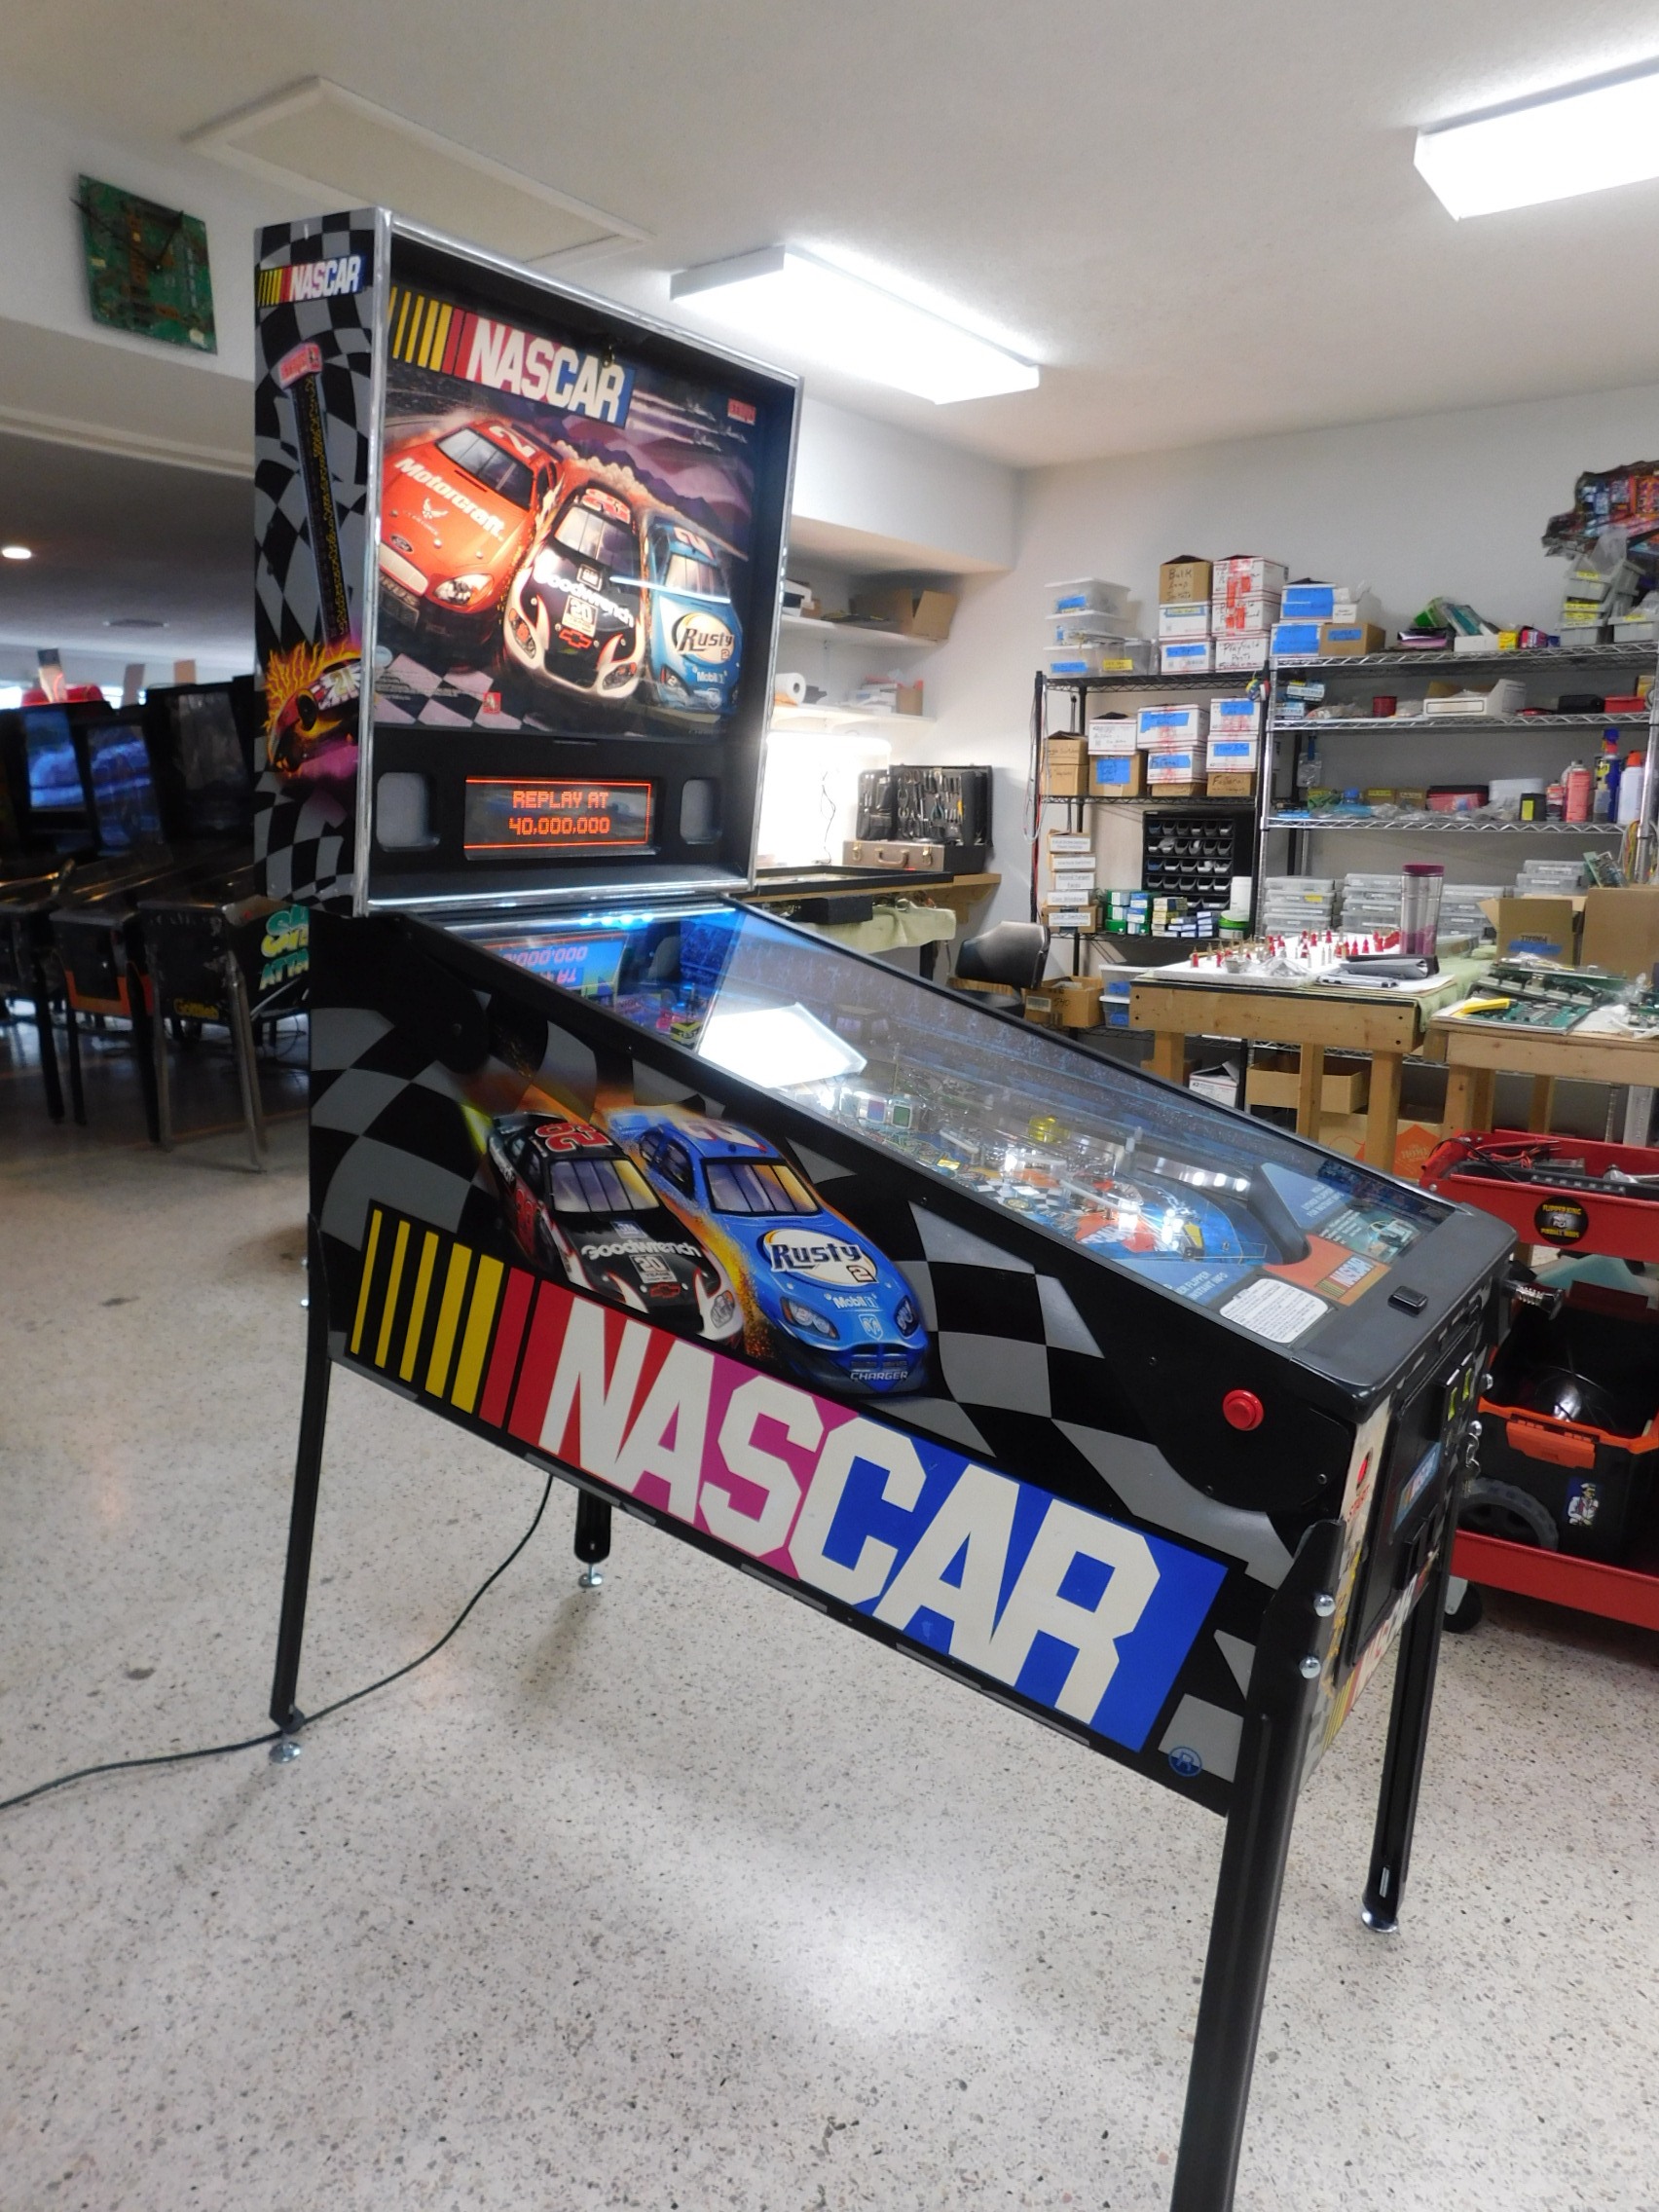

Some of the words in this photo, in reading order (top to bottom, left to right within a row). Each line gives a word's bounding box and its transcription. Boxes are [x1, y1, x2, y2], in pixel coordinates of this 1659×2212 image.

[289, 256, 361, 302] NASCAR
[465, 317, 625, 423] NASCAR
[394, 458, 504, 537] Motorcraft
[679, 627, 733, 651] Rusty
[512, 791, 583, 809] REPLAY
[587, 791, 609, 809] AT
[508, 817, 610, 835] 40,000,000
[581, 1240, 702, 1260] Goodwrench
[771, 1242, 862, 1271] Rusty
[832, 1295, 867, 1309] Mobil
[850, 1371, 908, 1382] CHARGER
[537, 1294, 1161, 1725] NASCAR
